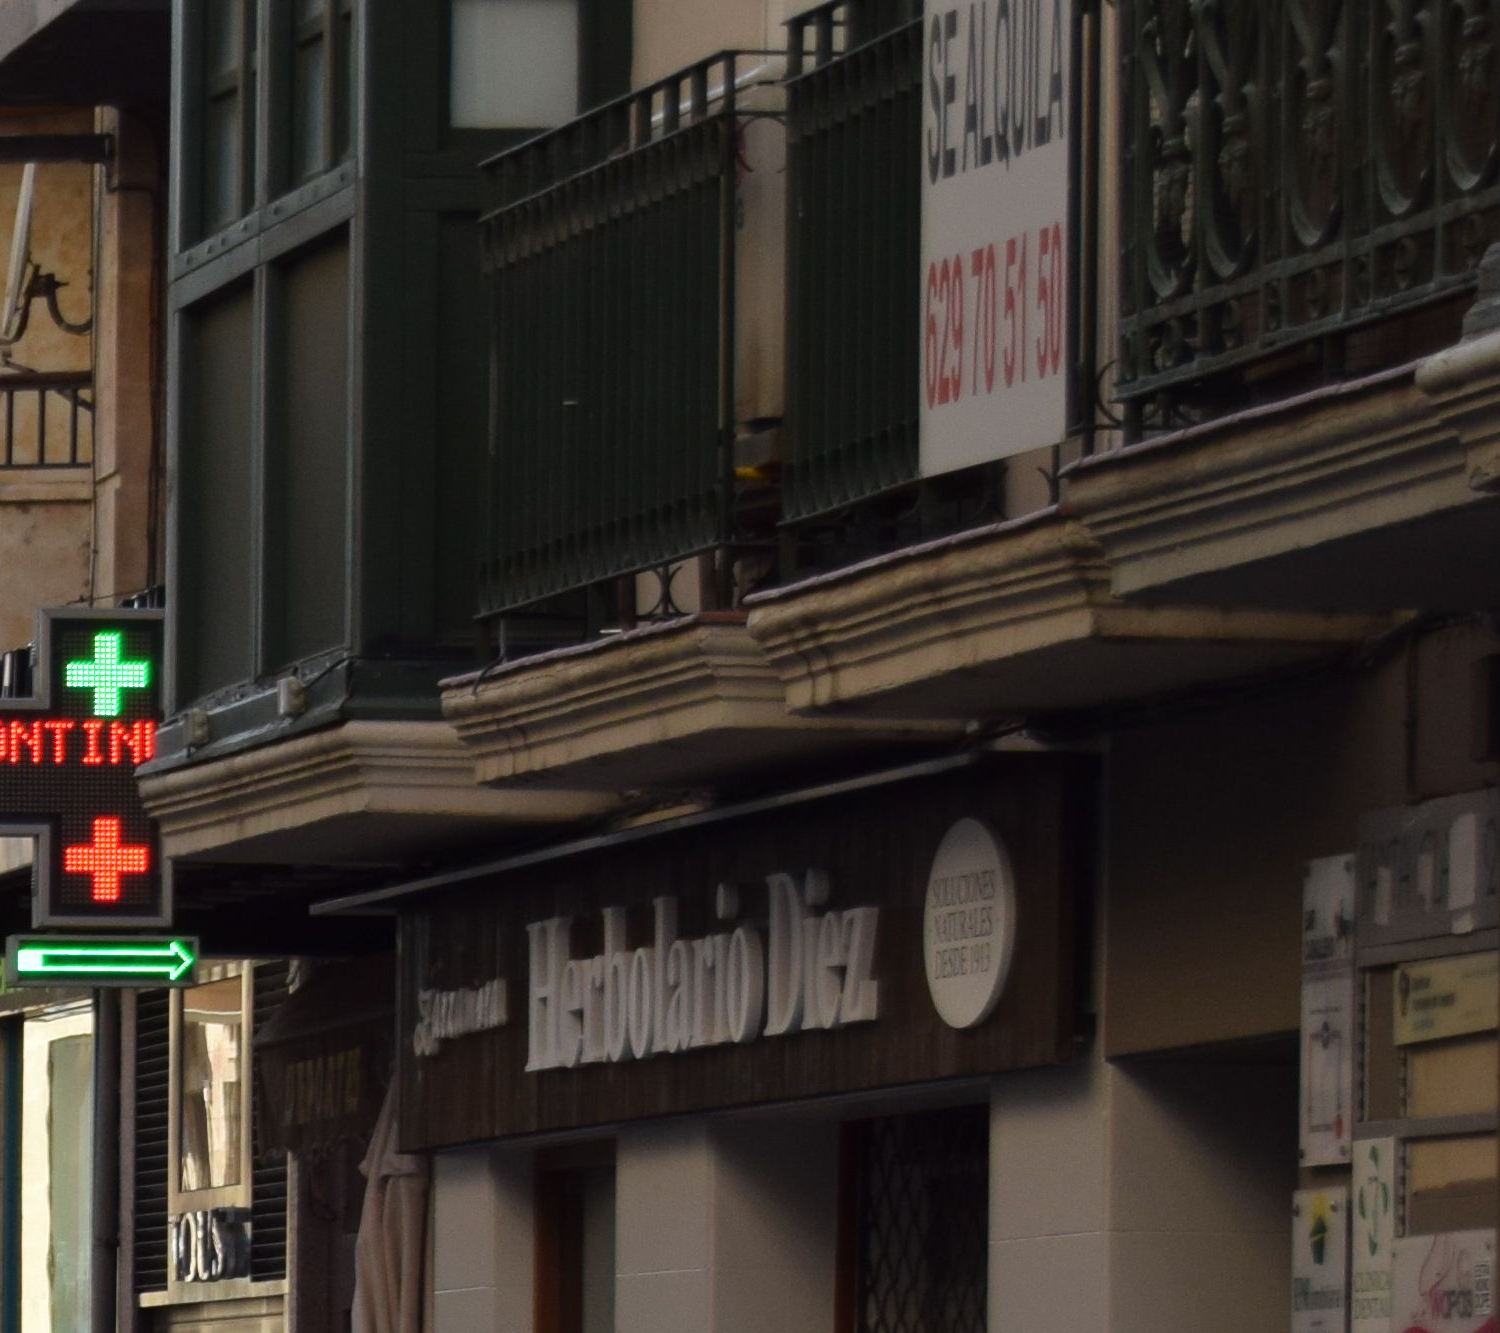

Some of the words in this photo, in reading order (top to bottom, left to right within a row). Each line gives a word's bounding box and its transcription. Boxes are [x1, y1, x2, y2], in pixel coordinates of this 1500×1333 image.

[927, 9, 958, 185] SE
[962, 0, 1066, 172] ALQUILA
[926, 253, 964, 410] 629
[971, 242, 997, 397] 70
[1004, 231, 1029, 389] 51
[1037, 221, 1063, 380] 50
[524, 880, 764, 1074] Herbolario
[763, 868, 880, 1038] Diez
